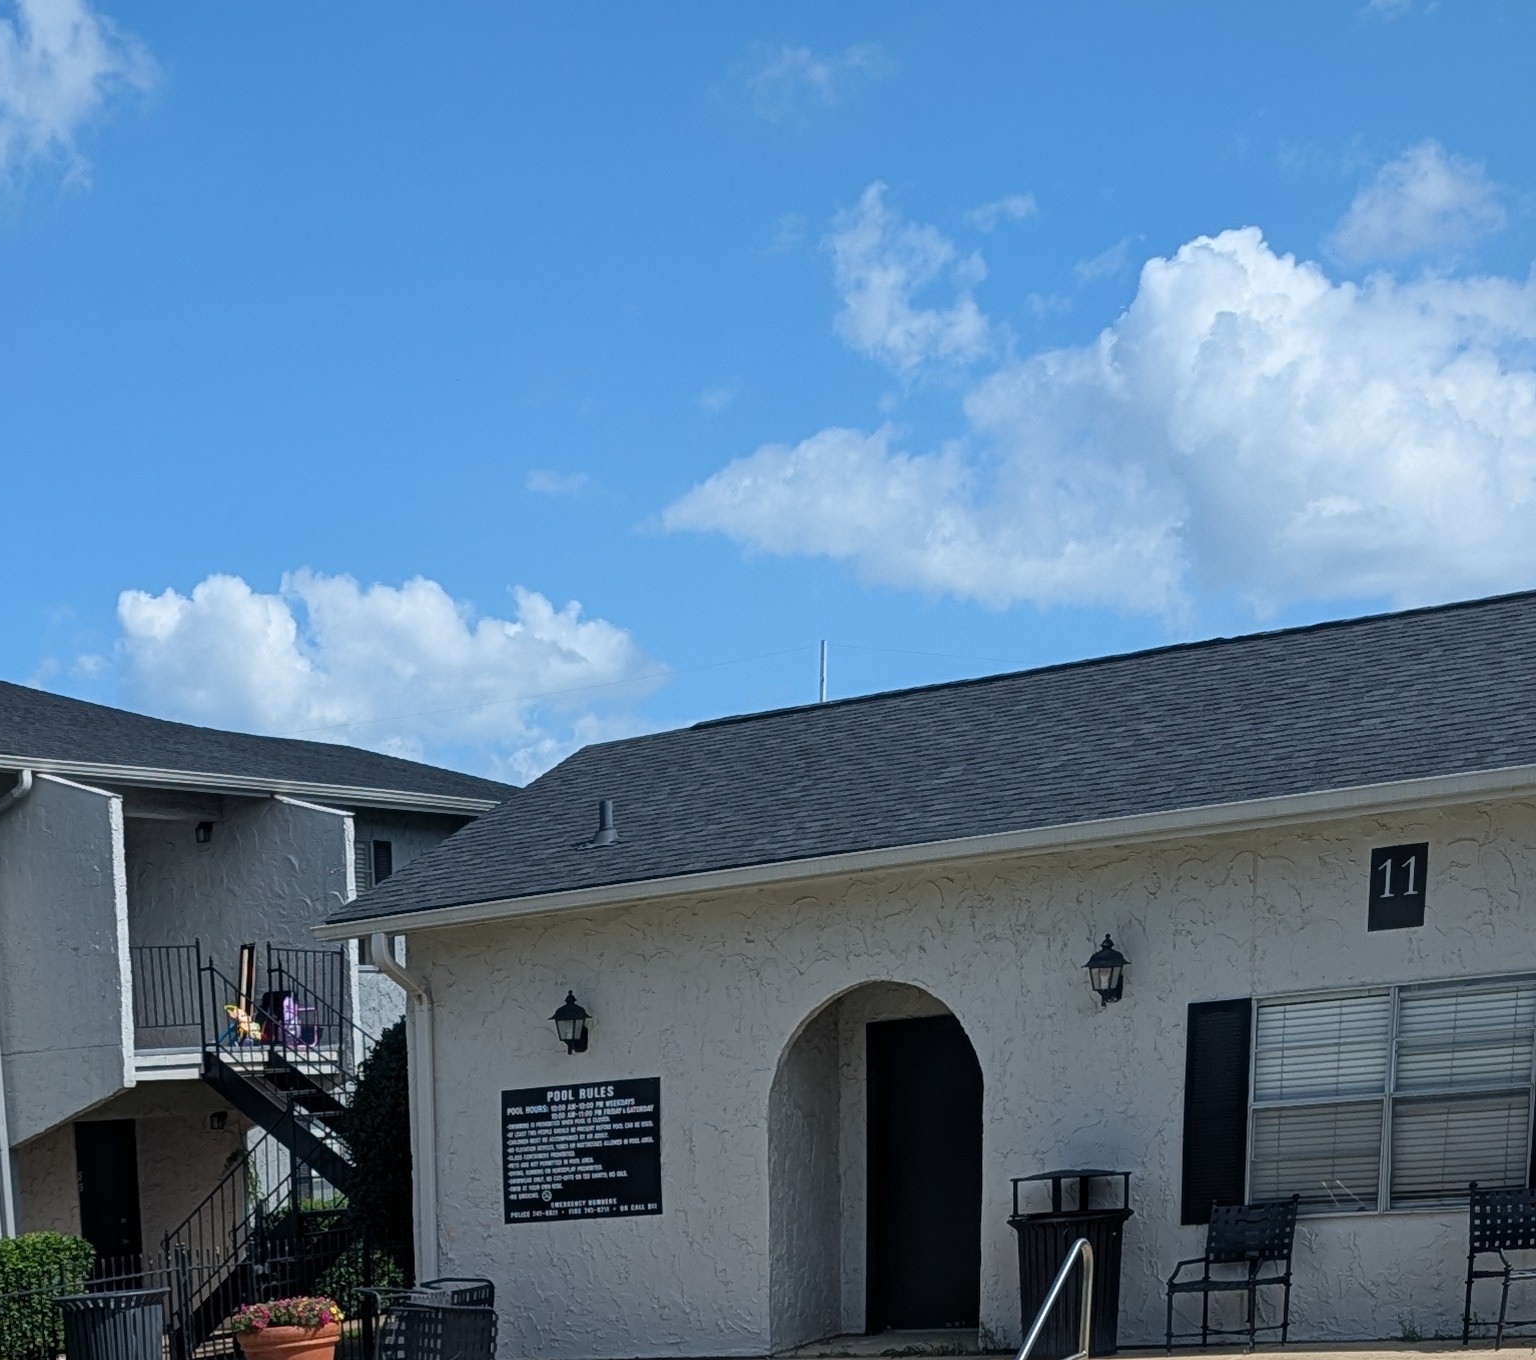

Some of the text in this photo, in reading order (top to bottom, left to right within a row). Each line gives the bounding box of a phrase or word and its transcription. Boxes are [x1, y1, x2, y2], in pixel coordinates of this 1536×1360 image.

[1378, 855, 1419, 898] 11
[547, 1086, 614, 1102] POOL RULES
[507, 1107, 524, 1116] POOL
[605, 1098, 635, 1107] WEEKDAYS
[551, 1198, 617, 1208] EMERGENCY NUMBERS
